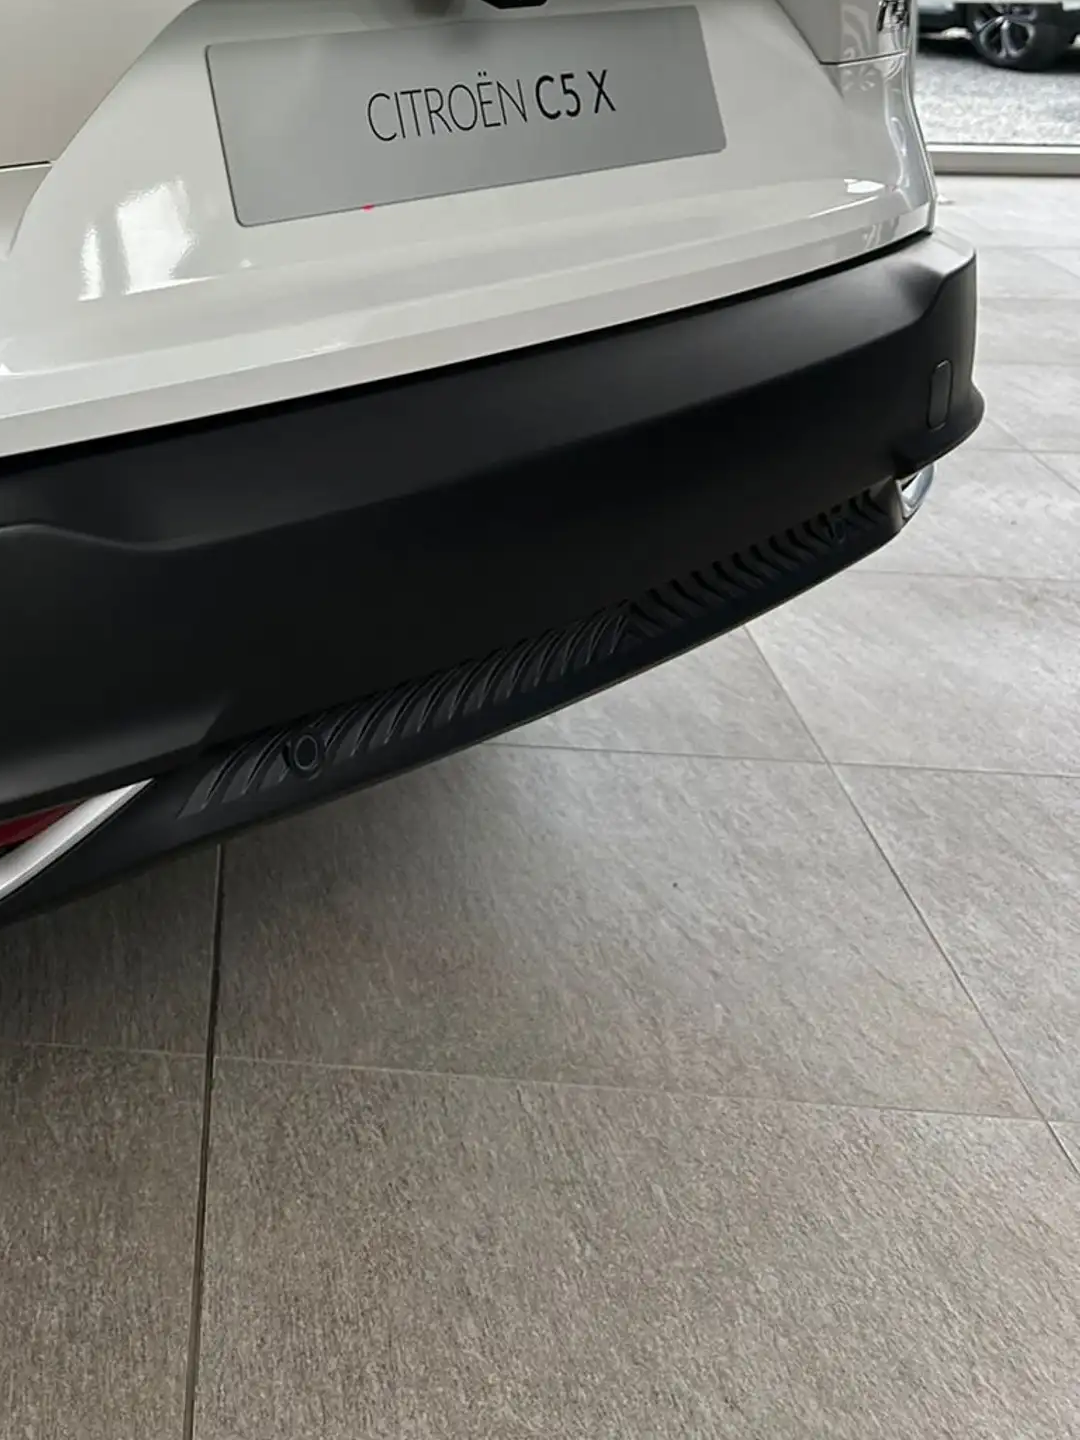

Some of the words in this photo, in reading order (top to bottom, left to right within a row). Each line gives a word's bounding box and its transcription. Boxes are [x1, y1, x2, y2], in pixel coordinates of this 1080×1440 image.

[367, 71, 528, 142] CITROËN
[535, 72, 581, 120] C5
[587, 69, 617, 114] X
